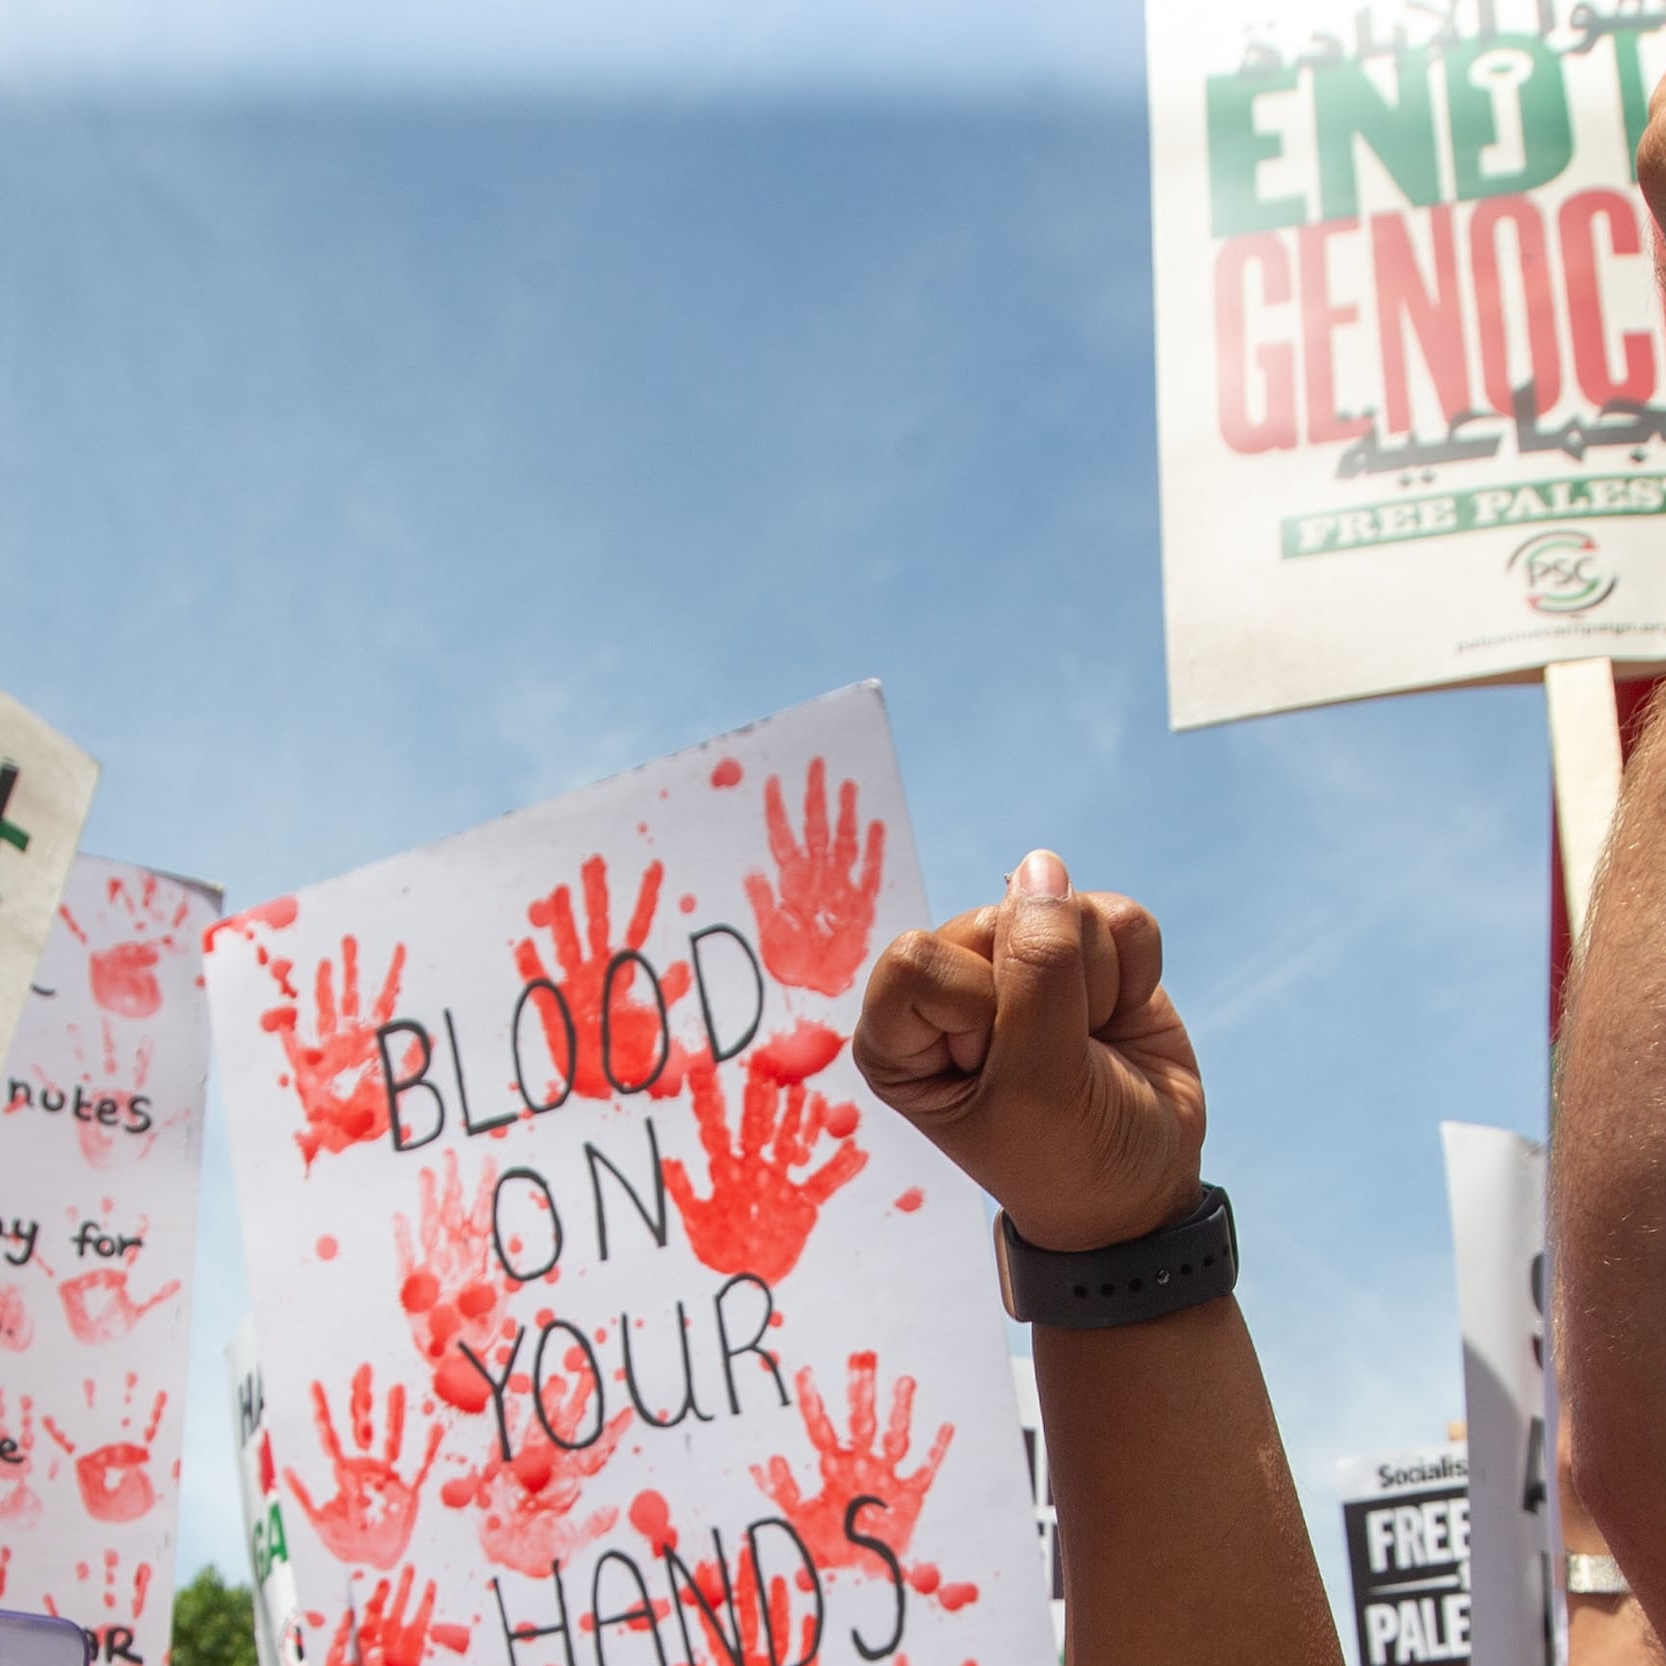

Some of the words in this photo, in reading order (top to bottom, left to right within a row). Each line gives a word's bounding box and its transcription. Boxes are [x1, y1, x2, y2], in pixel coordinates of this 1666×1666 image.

[1206, 31, 1573, 238] END
[1296, 487, 1457, 551] FREE
[1525, 555, 1599, 588] PSC
[377, 925, 764, 1152] BLOOD
[70, 1219, 144, 1258] for
[491, 1118, 669, 1281] ON
[459, 1273, 791, 1462] YOUR
